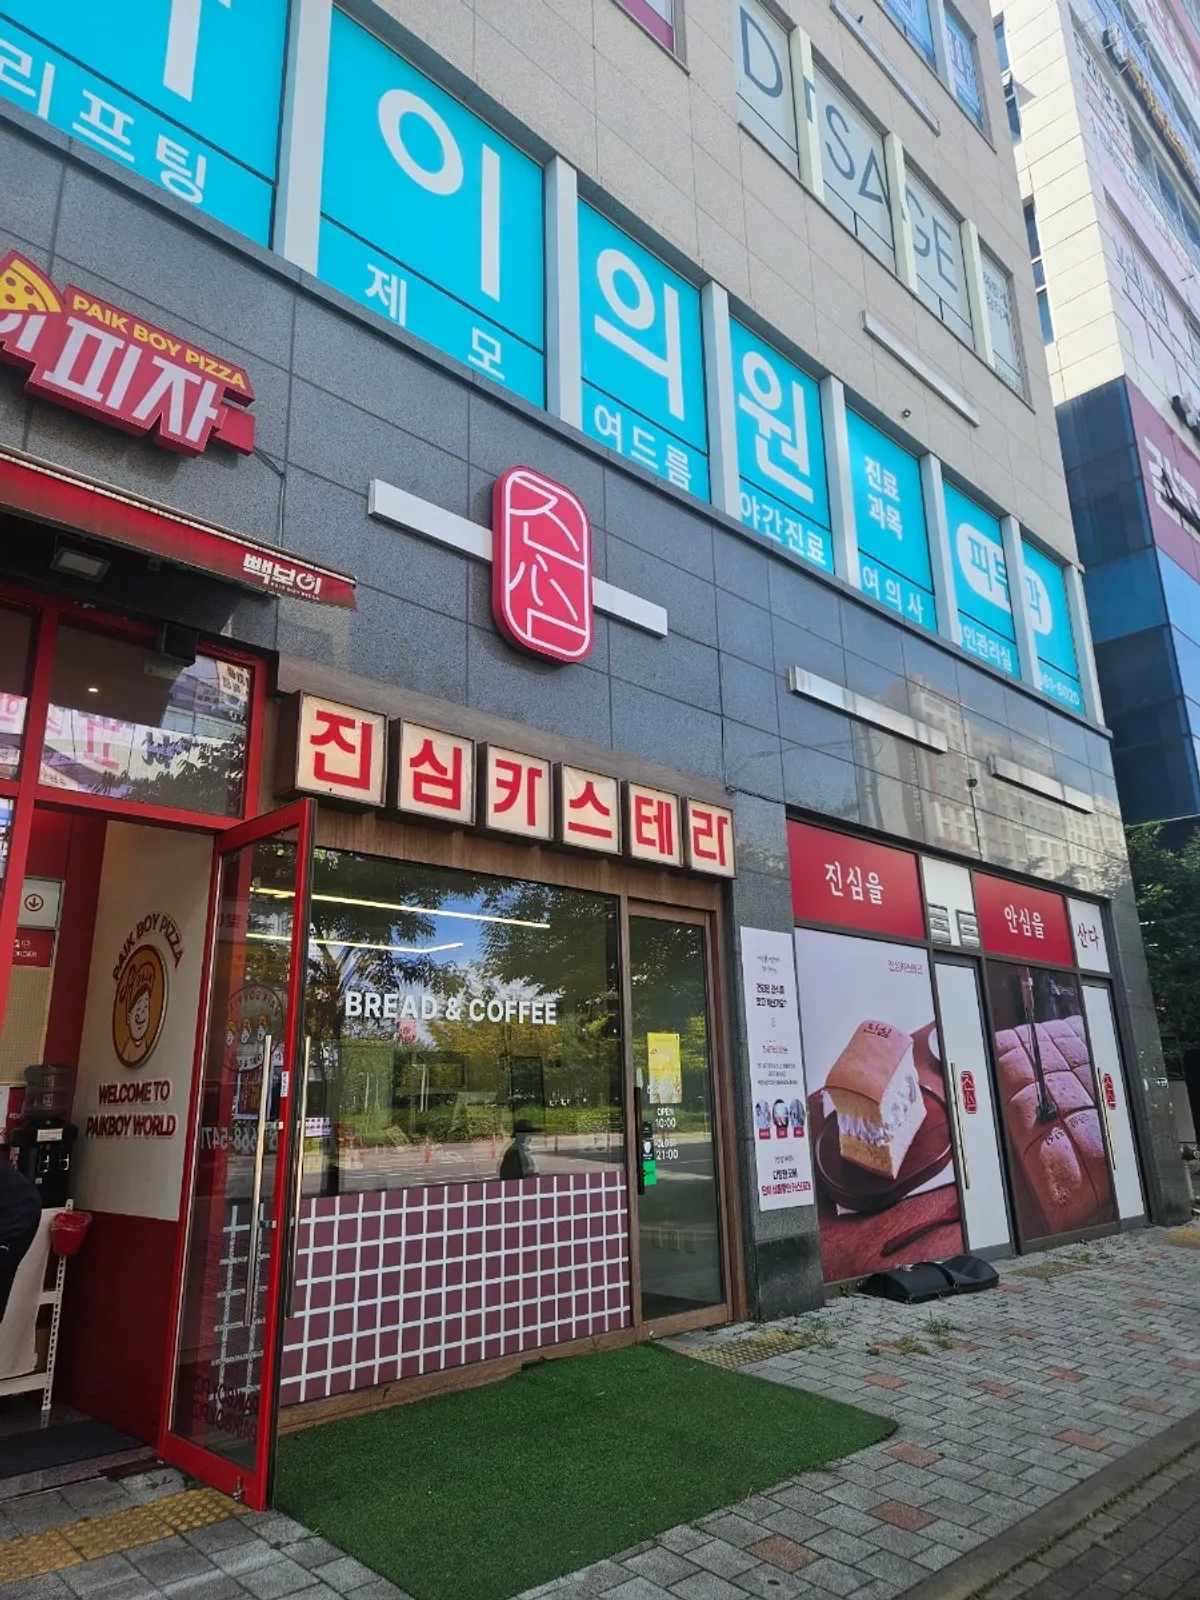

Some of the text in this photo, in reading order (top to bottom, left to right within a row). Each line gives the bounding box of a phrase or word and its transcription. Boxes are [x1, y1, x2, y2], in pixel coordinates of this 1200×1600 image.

[72, 294, 247, 389] PAIK BOY PIZZA
[594, 404, 692, 492] 여드름
[864, 455, 901, 503] 진료
[867, 493, 904, 542] 과목
[310, 709, 728, 867] 진심카스테라
[824, 861, 884, 905] 진심을
[1004, 904, 1045, 940] 안심을
[112, 931, 136, 982] PAIK
[136, 912, 160, 937] BOY
[344, 991, 558, 1026] BREAD & COFFEE
[99, 1080, 171, 1105] WELCOME TO
[657, 1107, 675, 1116] OPEN
[86, 1115, 132, 1138] PAIKBOY
[133, 1113, 177, 1137] WORLD
[655, 1117, 676, 1128] 10:00
[656, 1148, 679, 1161] 21:00
